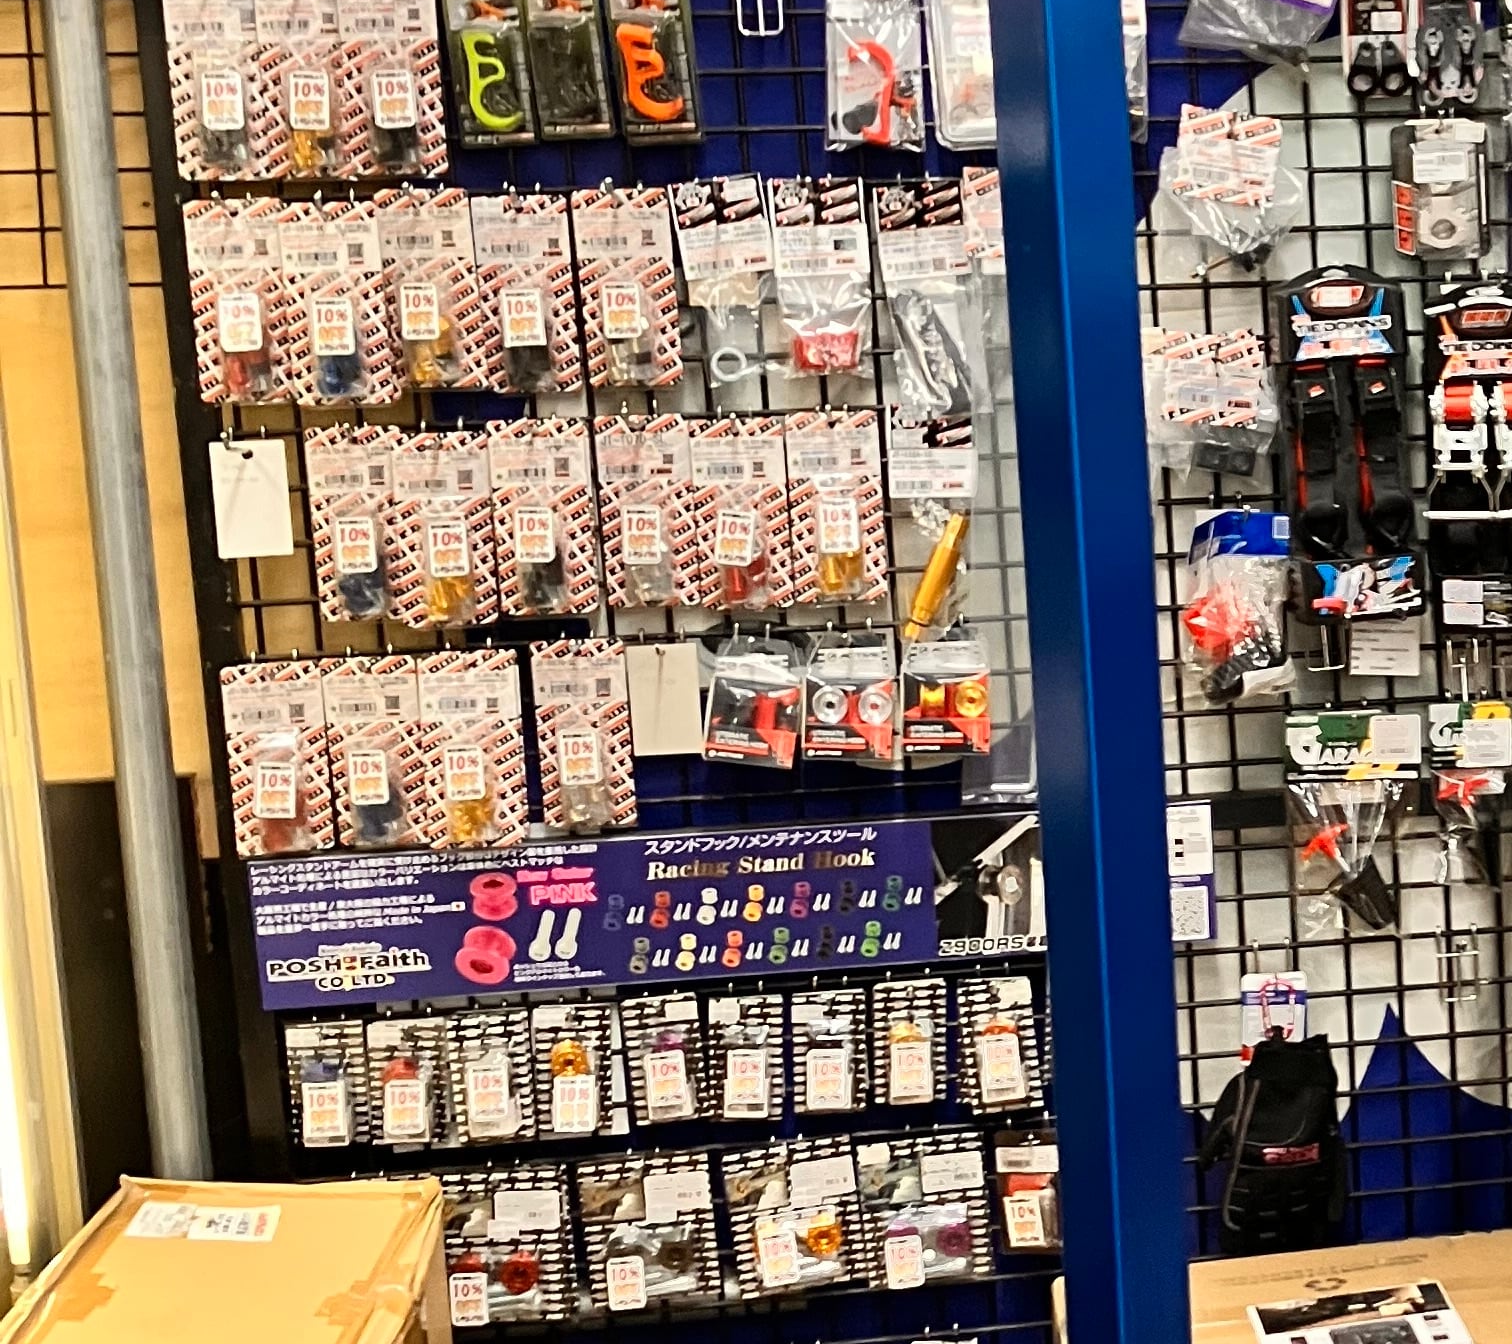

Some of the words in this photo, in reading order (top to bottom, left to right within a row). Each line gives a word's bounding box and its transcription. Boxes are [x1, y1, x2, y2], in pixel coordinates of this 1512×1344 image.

[644, 827, 878, 857] スタンドフック/メンテナンスツール
[648, 858, 729, 881] Racing
[738, 852, 804, 875] Stand
[813, 848, 876, 869] Hook
[530, 881, 598, 906] PINK
[269, 959, 342, 977] POSH
[360, 950, 427, 970] Faith
[319, 976, 344, 989] CO
[351, 972, 387, 987] LTD
